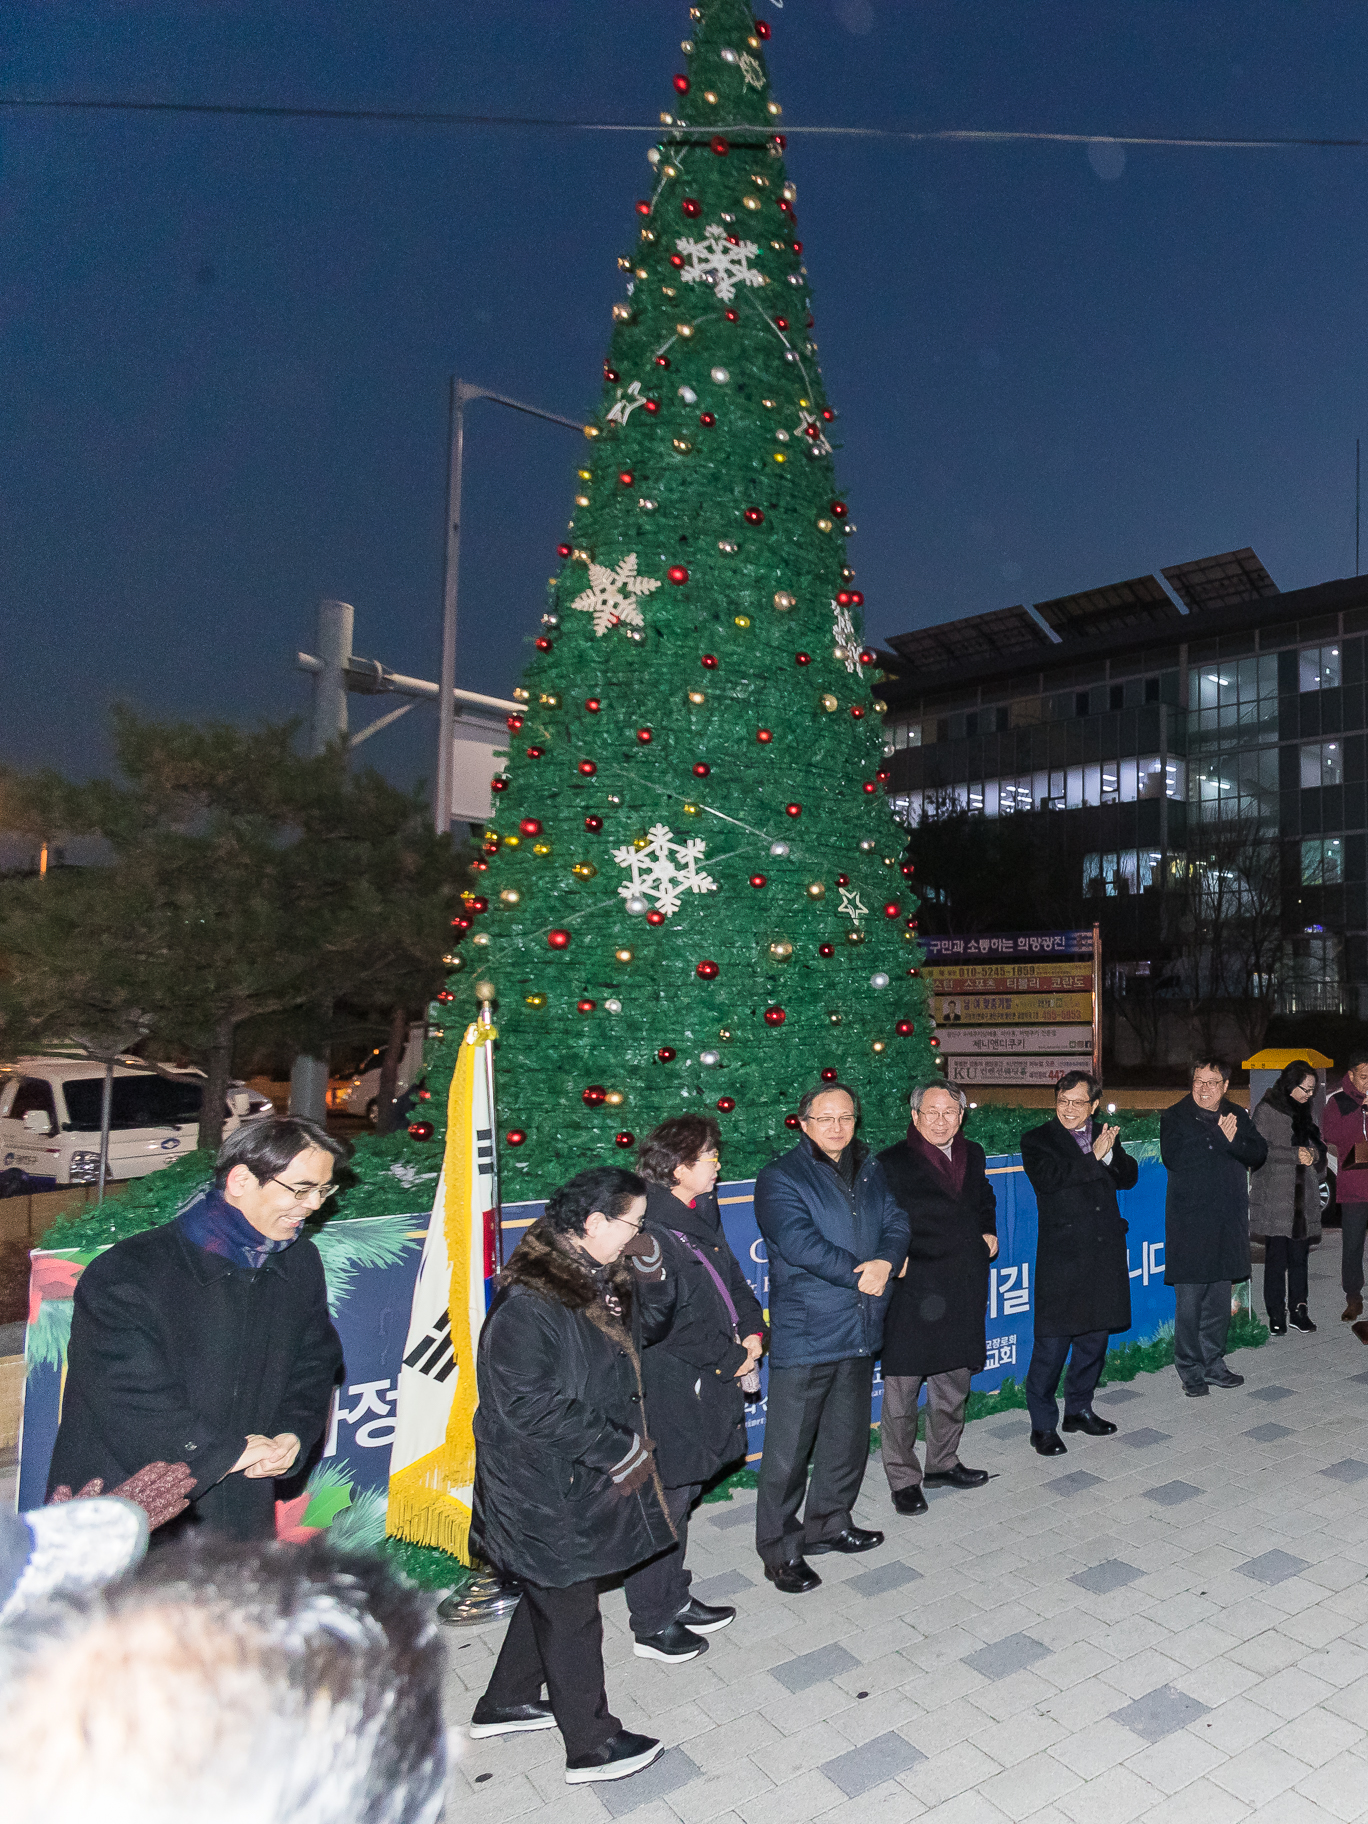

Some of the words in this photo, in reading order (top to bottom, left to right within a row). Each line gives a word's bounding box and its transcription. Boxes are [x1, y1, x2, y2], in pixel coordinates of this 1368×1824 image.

[930, 939, 965, 954] 구민과
[967, 938, 1014, 953] 소통하는
[1017, 936, 1065, 951] 희망광진
[964, 978, 996, 990] 스포츠
[1006, 977, 1040, 990] 티볼리
[1051, 976, 1085, 989] 코란도
[953, 1067, 977, 1080] KU
[983, 1345, 1017, 1371] 교회
